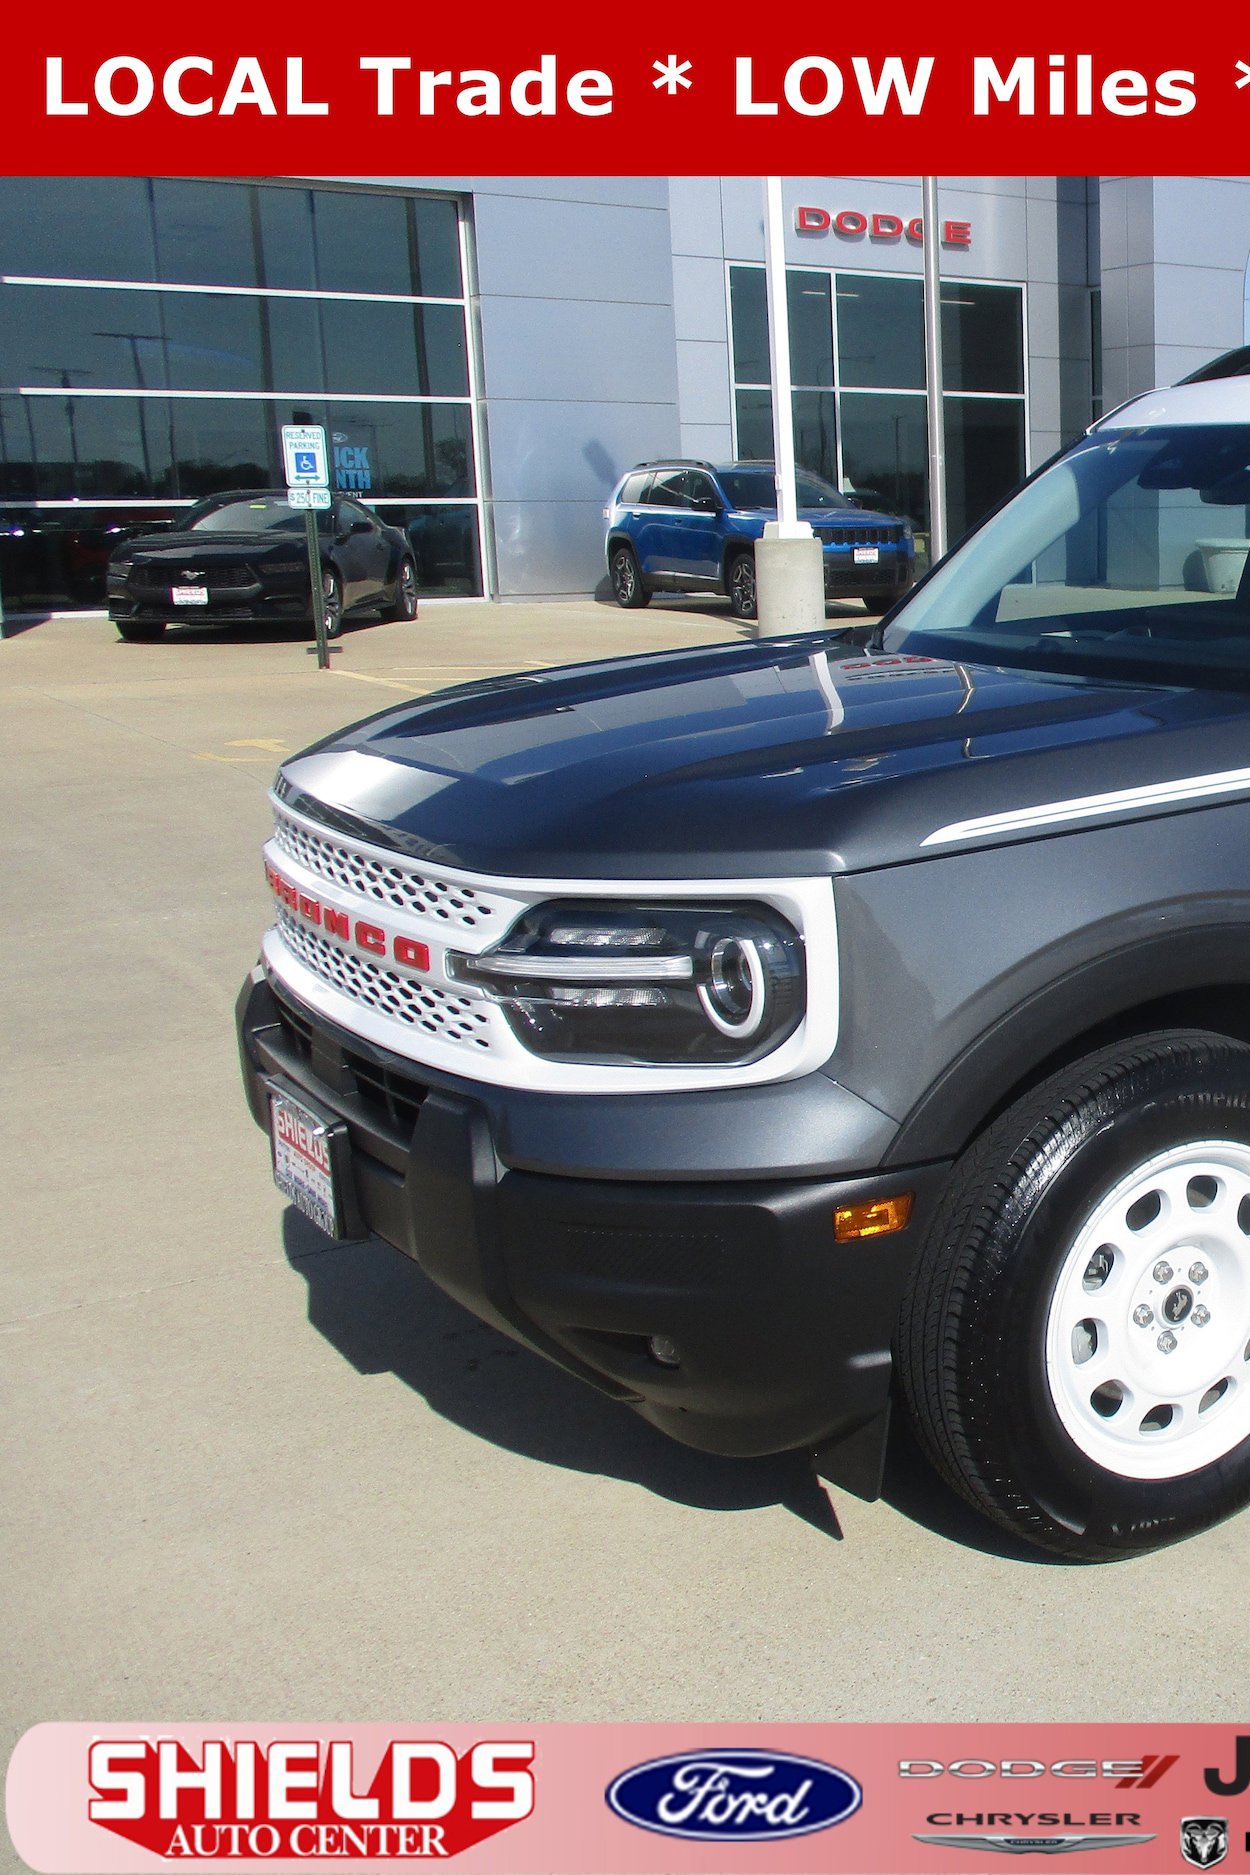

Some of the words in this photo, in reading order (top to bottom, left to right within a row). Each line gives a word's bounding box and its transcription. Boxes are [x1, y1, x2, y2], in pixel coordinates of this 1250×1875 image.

[285, 431, 321, 440] RESERVED
[289, 441, 320, 450] PARKING
[312, 492, 329, 504] FINE
[276, 1109, 331, 1170] SHIELDS
